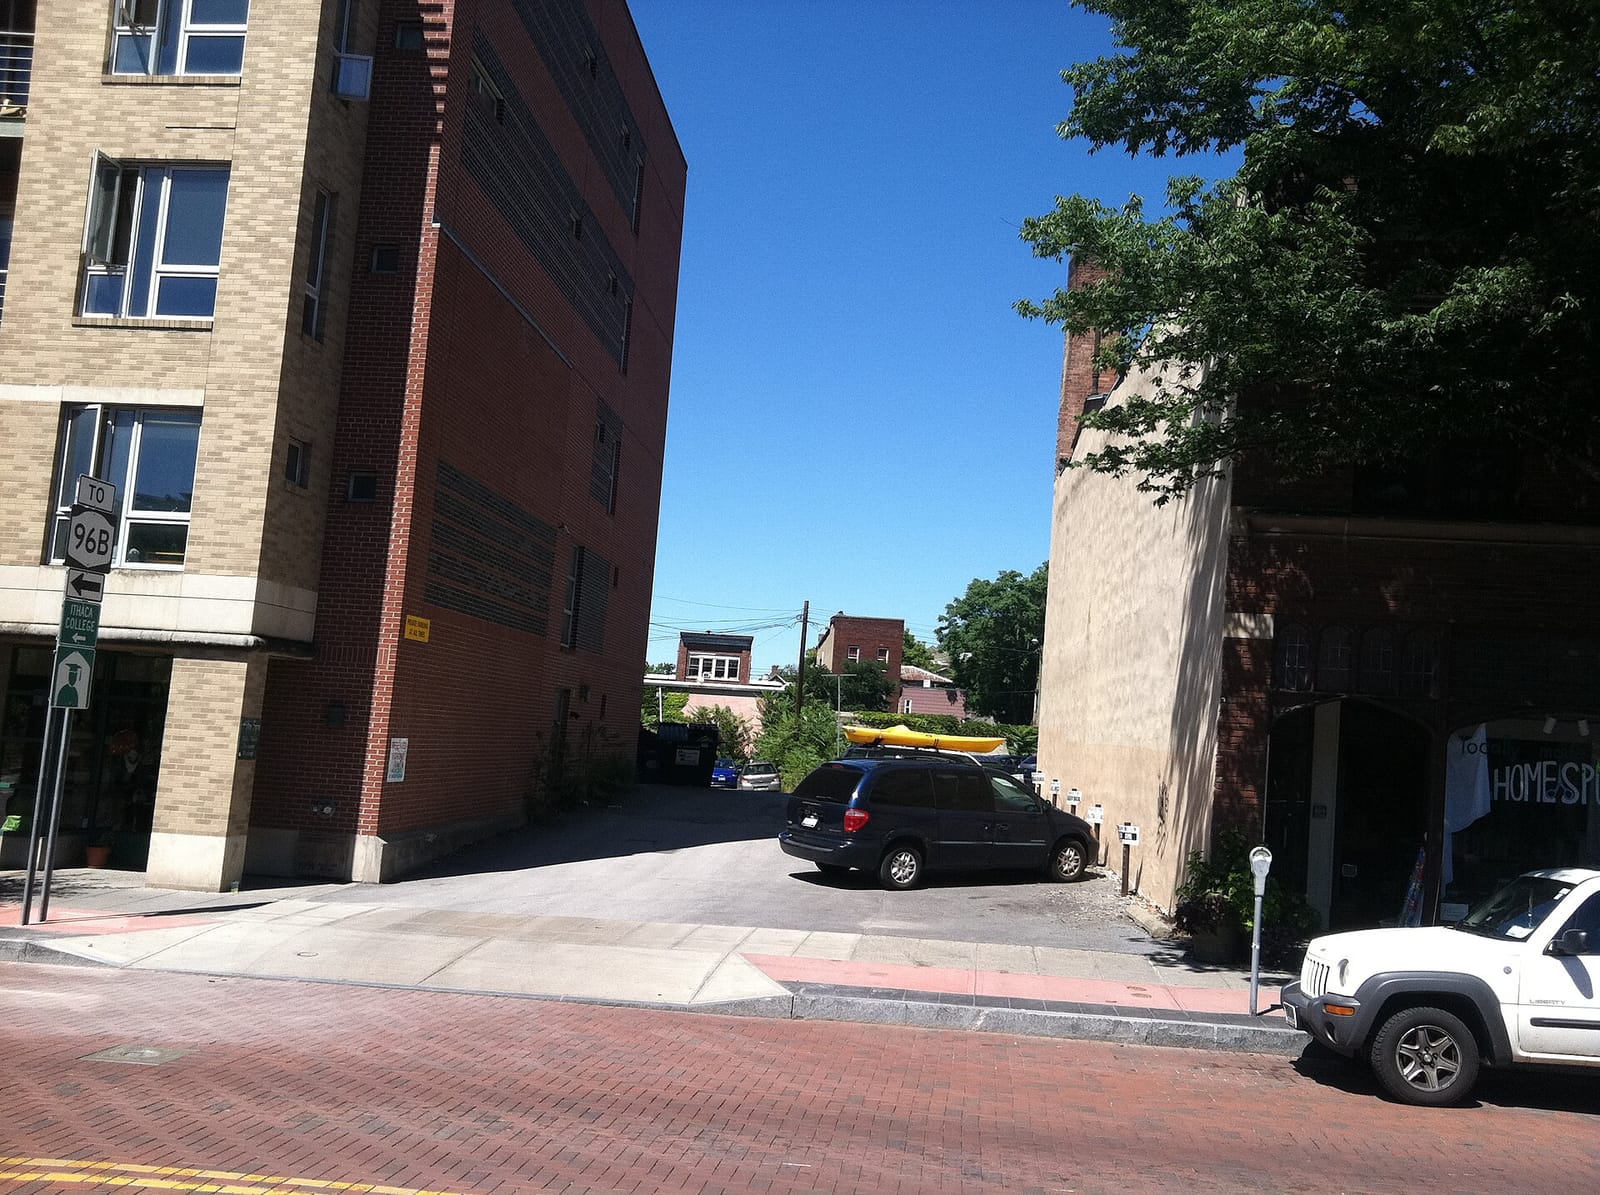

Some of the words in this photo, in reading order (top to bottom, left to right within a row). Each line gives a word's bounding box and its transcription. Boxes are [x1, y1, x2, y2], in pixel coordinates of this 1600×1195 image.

[88, 483, 105, 504] TO
[74, 523, 110, 555] 96B
[70, 604, 93, 619] ITHACA
[65, 617, 96, 632] COLLEGE
